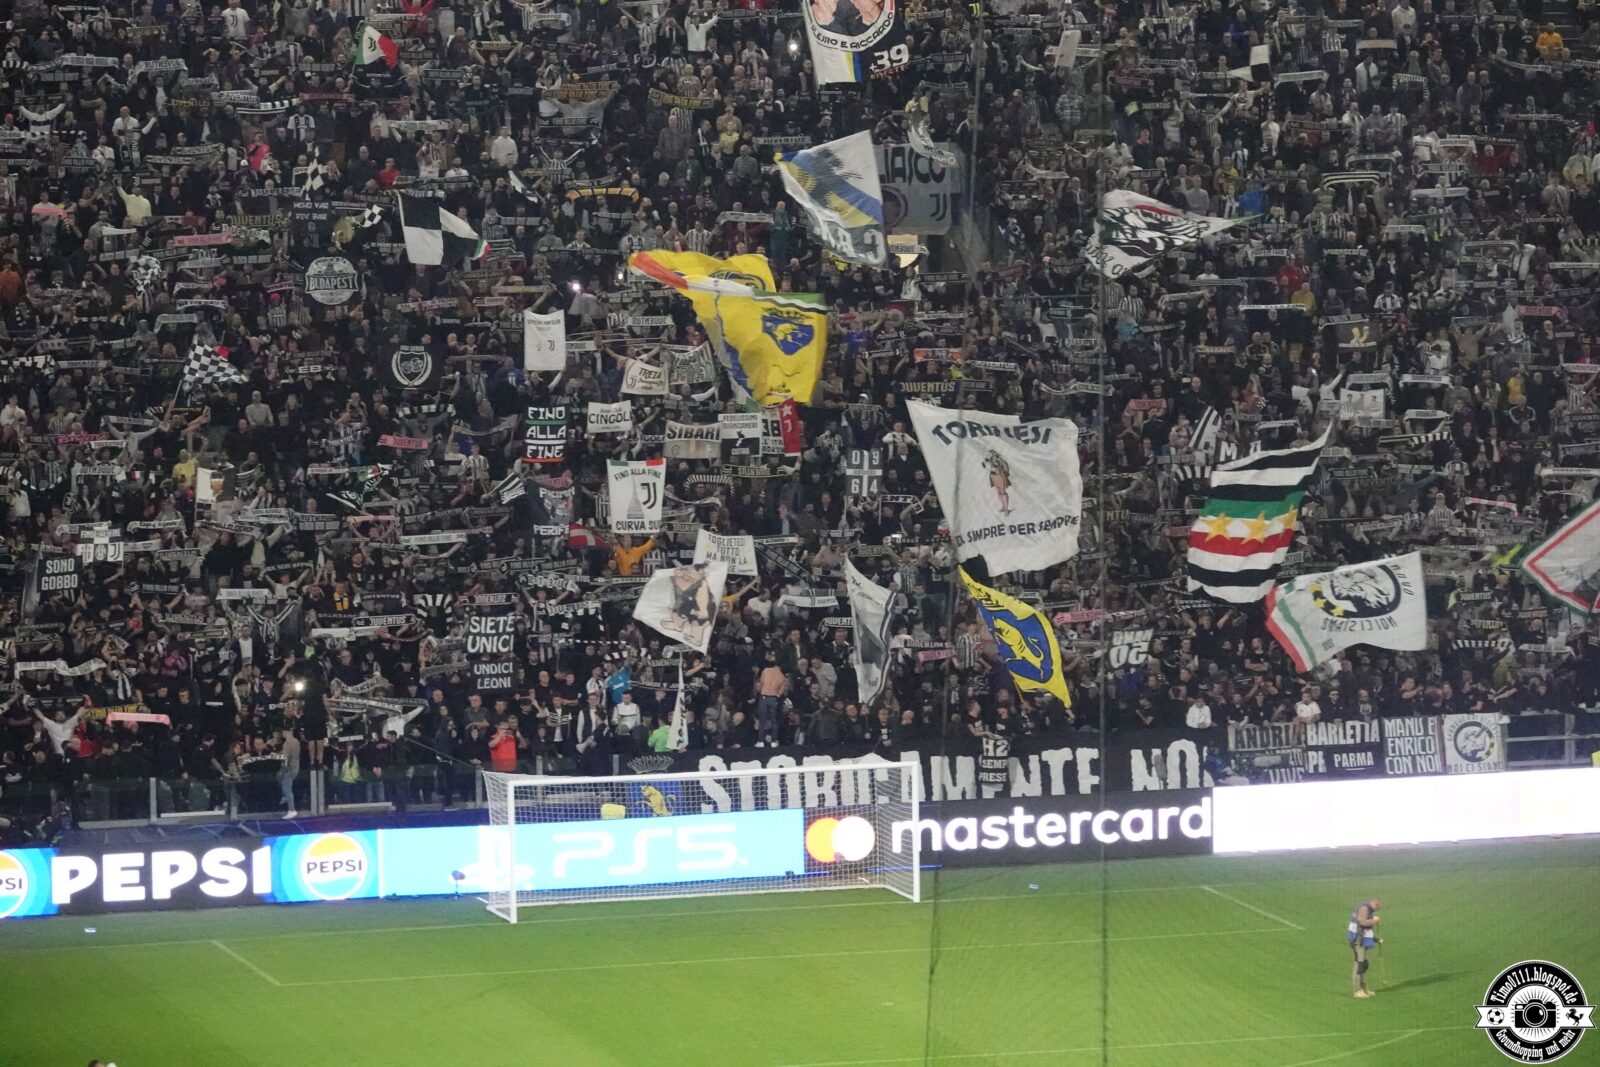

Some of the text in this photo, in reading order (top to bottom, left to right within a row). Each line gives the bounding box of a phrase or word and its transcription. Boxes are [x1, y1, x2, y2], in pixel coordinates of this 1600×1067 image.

[309, 277, 353, 290] BUDAPEST
[901, 381, 955, 392] JUVENTUS
[527, 406, 566, 420] FINO
[526, 425, 567, 439] ALLA
[526, 445, 564, 458] FINE
[614, 470, 630, 482] FINO
[648, 469, 662, 479] FINE
[533, 524, 570, 536] PERIFE
[615, 520, 661, 532] CURVA SU
[1010, 522, 1036, 535] PER
[1038, 515, 1079, 532] SEMPRE
[46, 558, 75, 574] SONO
[41, 574, 78, 591] GOBBO
[371, 615, 406, 626] JUVENTUS
[468, 616, 516, 634] SIETE
[826, 617, 855, 628] JUVENT
[466, 634, 515, 654] UNICI
[474, 662, 514, 675] UNDICI
[476, 676, 512, 690] LEONI
[1235, 725, 1307, 750] ANDRI
[1307, 719, 1381, 746] BARLETTA
[1387, 736, 1435, 756] ENRICO
[1334, 751, 1375, 768] PARMA
[1384, 755, 1441, 774] CON NOI
[891, 797, 1213, 853] mastercard
[306, 858, 364, 875] PEPSI
[51, 847, 272, 904] PEPSI
